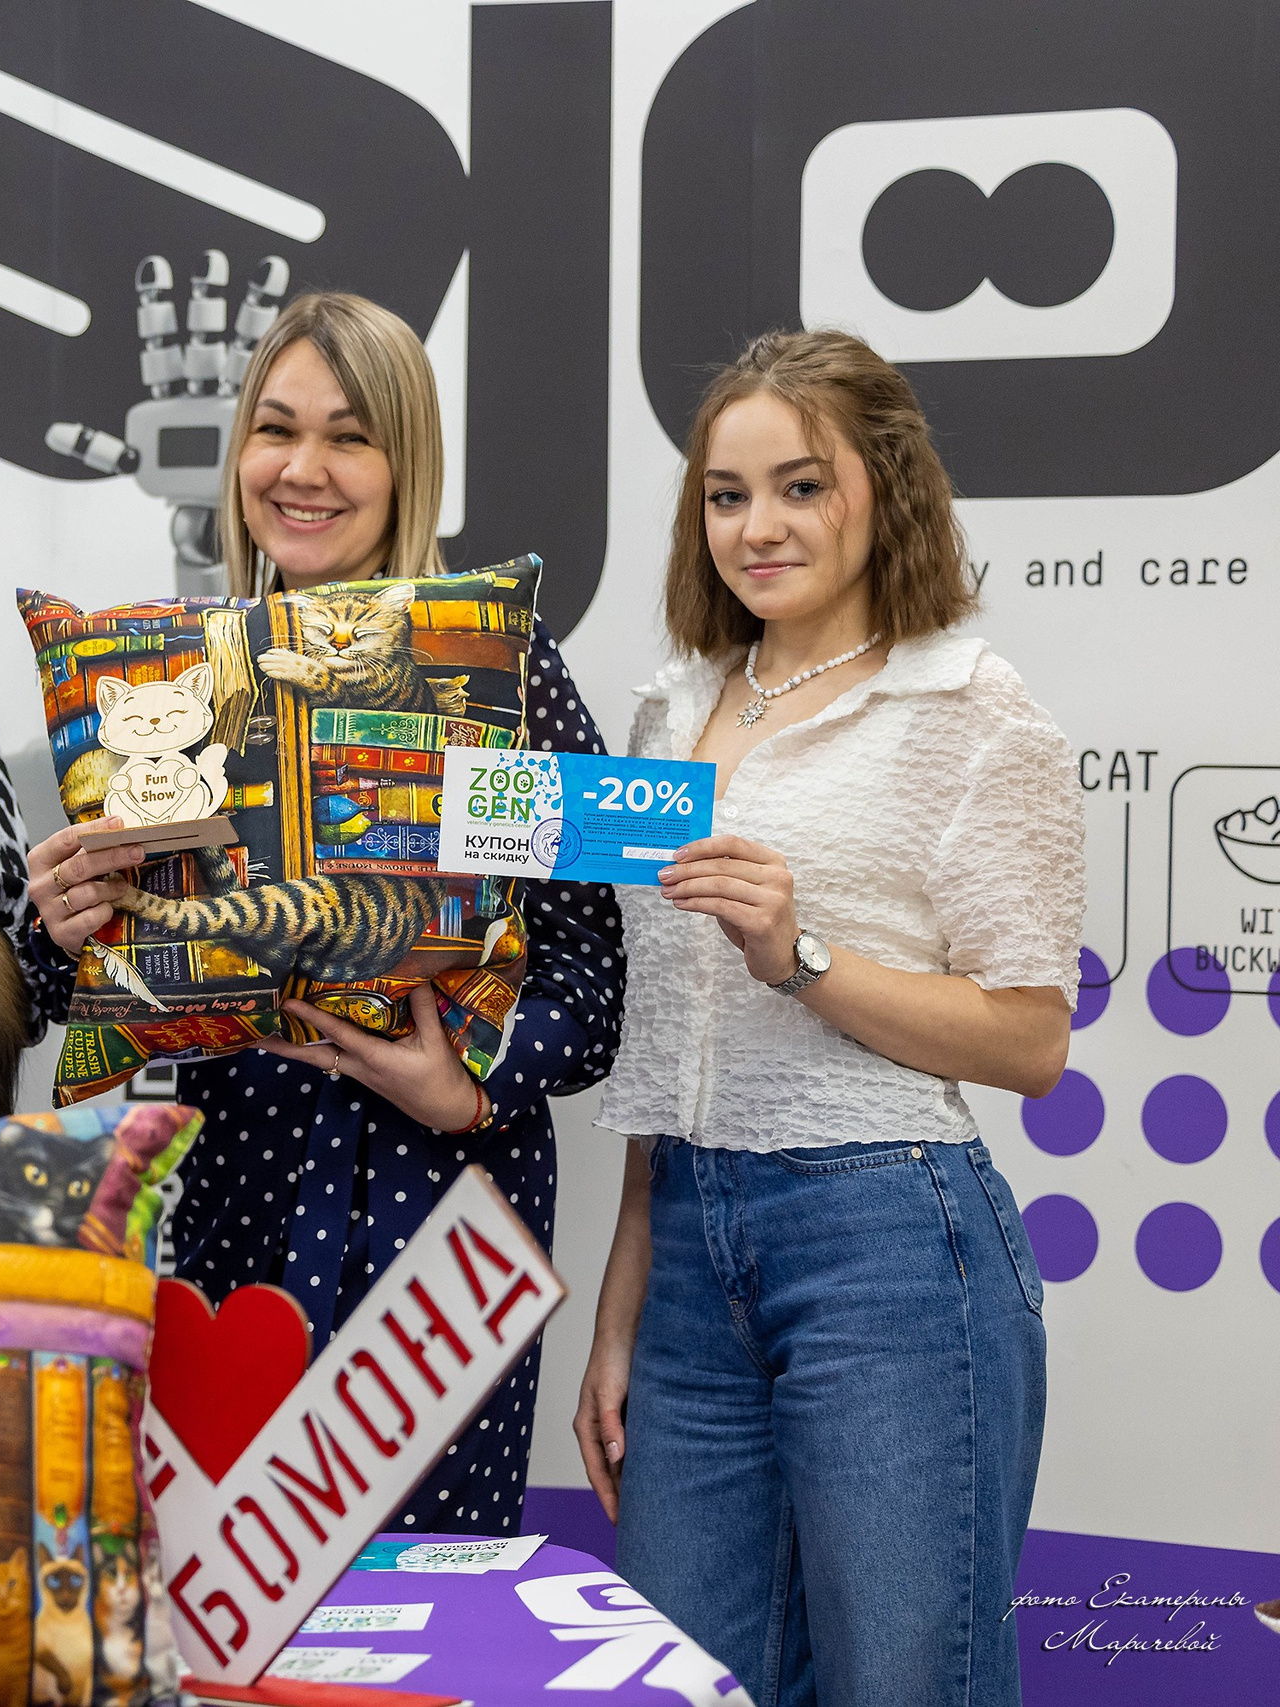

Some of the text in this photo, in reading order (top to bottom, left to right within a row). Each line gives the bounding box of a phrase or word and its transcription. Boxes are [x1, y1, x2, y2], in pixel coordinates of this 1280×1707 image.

[1026, 550, 1103, 587] and
[1140, 557, 1248, 586] care
[145, 774, 168, 786] Fun
[469, 767, 535, 794] ZOO
[1078, 750, 1159, 791] CAT
[141, 789, 176, 803] Show
[467, 794, 532, 821] GEN
[582, 776, 694, 816] -20%
[465, 834, 530, 852] КУПОН
[464, 850, 530, 865] на скидку
[1240, 907, 1280, 935] WI
[149, 1003, 207, 1014] Mooe
[74, 1030, 89, 1078] CUISINE
[85, 1031, 102, 1076] TRASHY
[168, 1215, 542, 1669] БОМОНД
